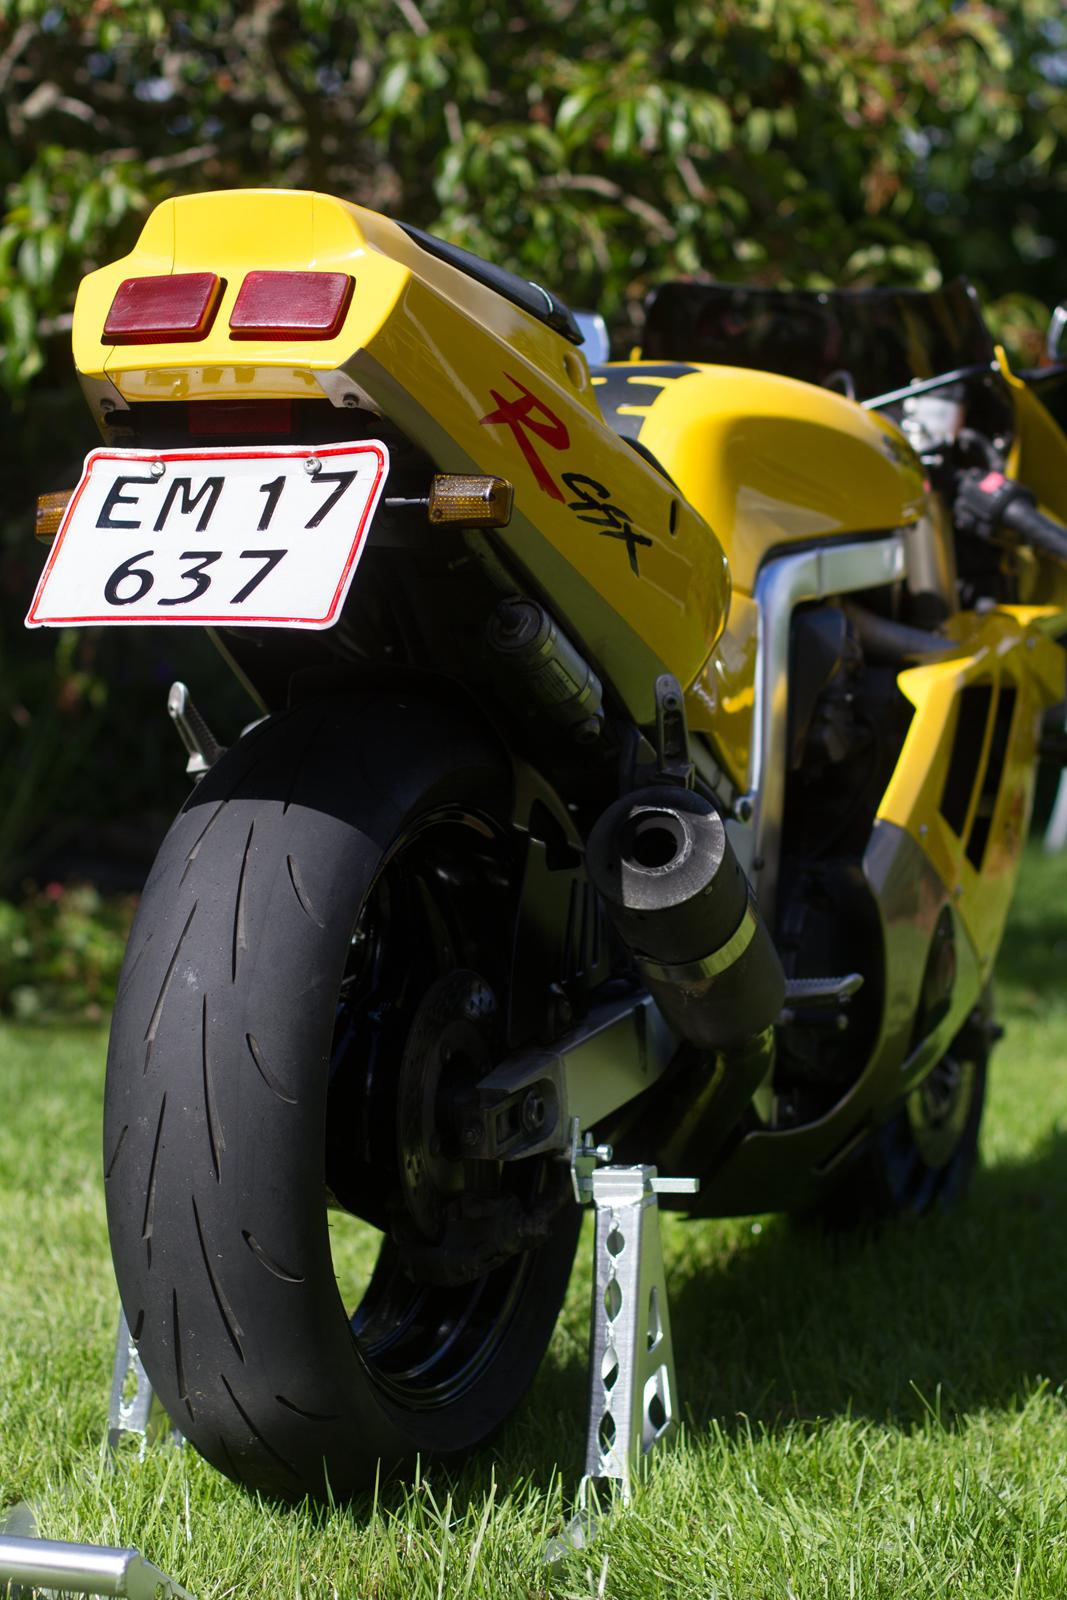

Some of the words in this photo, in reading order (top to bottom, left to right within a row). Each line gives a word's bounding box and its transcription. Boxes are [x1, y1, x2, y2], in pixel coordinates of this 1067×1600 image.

[95, 475, 225, 532] EM
[257, 470, 358, 531] 17
[104, 549, 288, 606] 637
